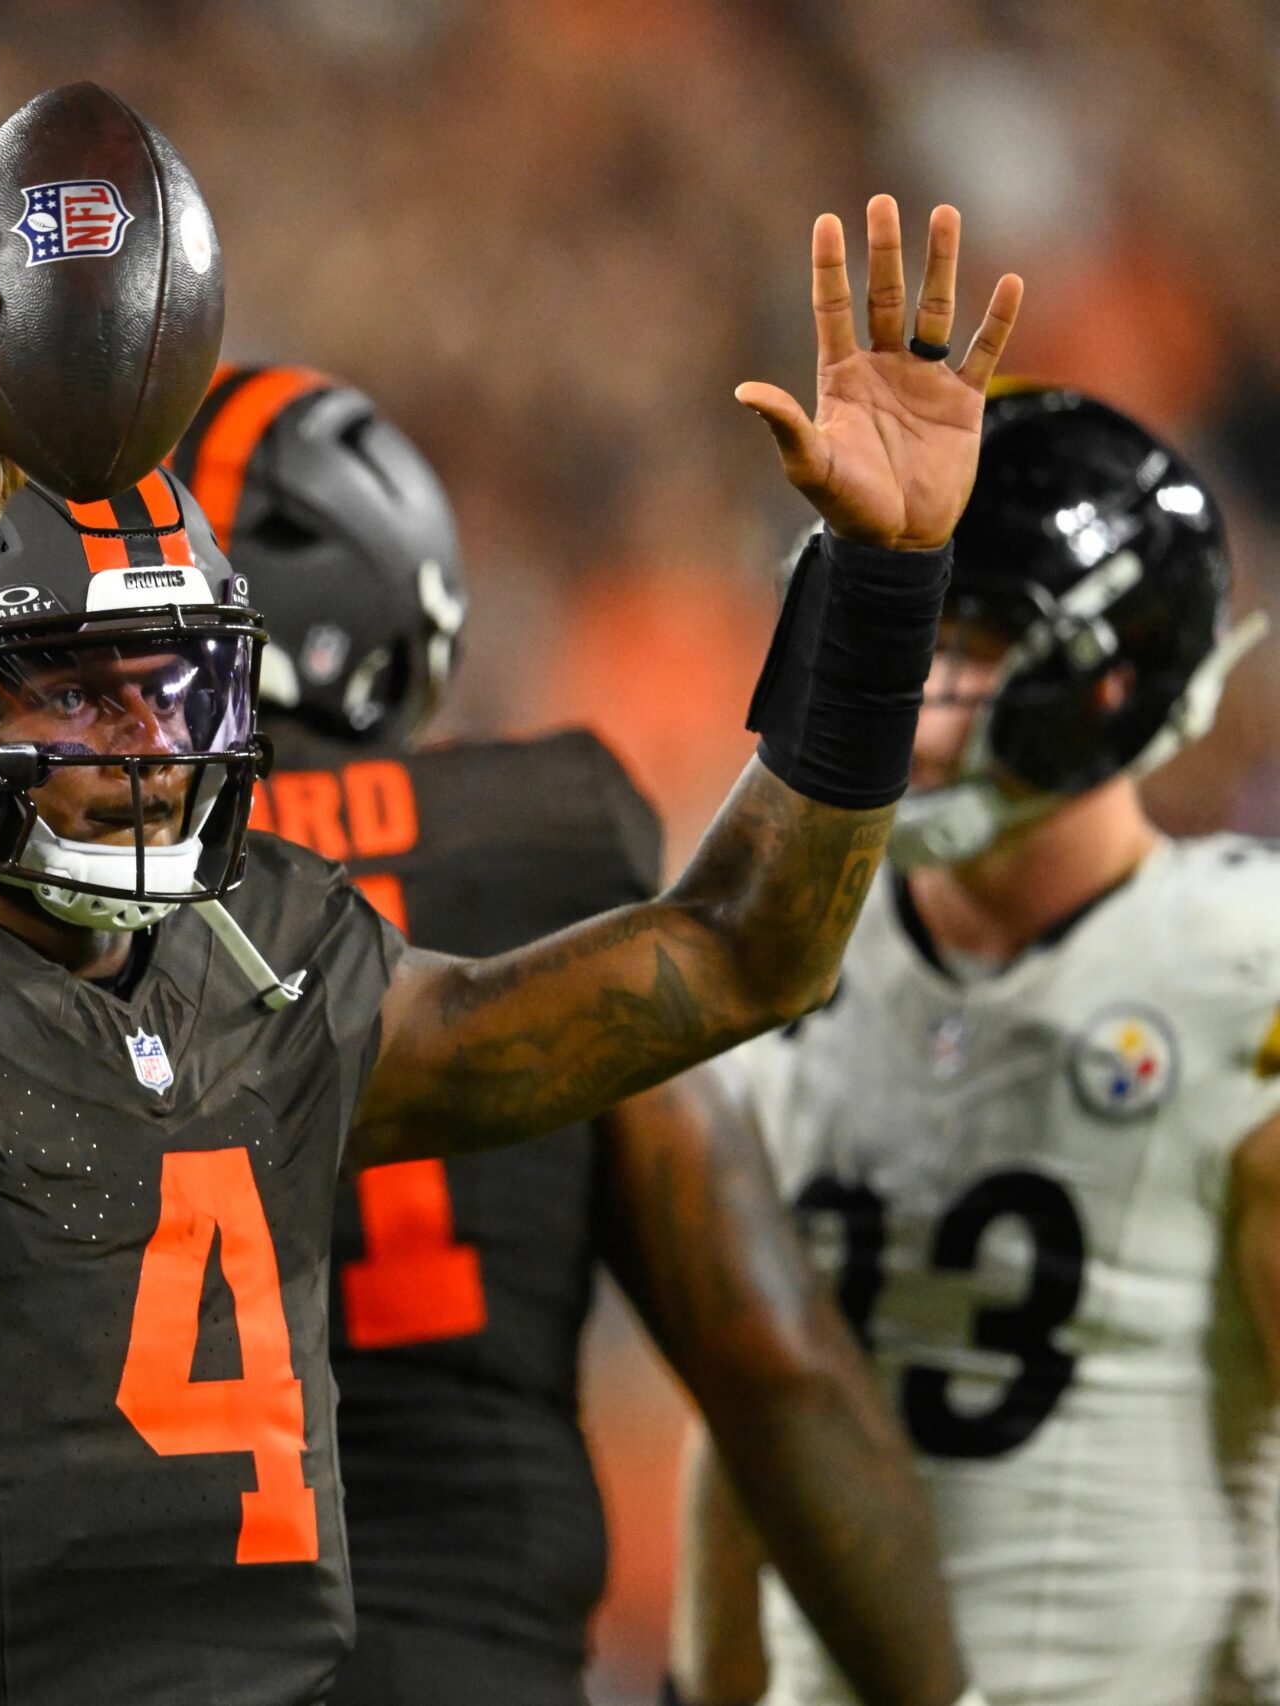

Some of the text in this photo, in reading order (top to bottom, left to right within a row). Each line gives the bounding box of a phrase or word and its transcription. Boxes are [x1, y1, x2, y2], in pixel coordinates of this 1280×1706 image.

[64, 187, 117, 250] NFL
[123, 570, 186, 590] BROWNS
[141, 1056, 168, 1083] NFL
[115, 1146, 319, 1565] 4
